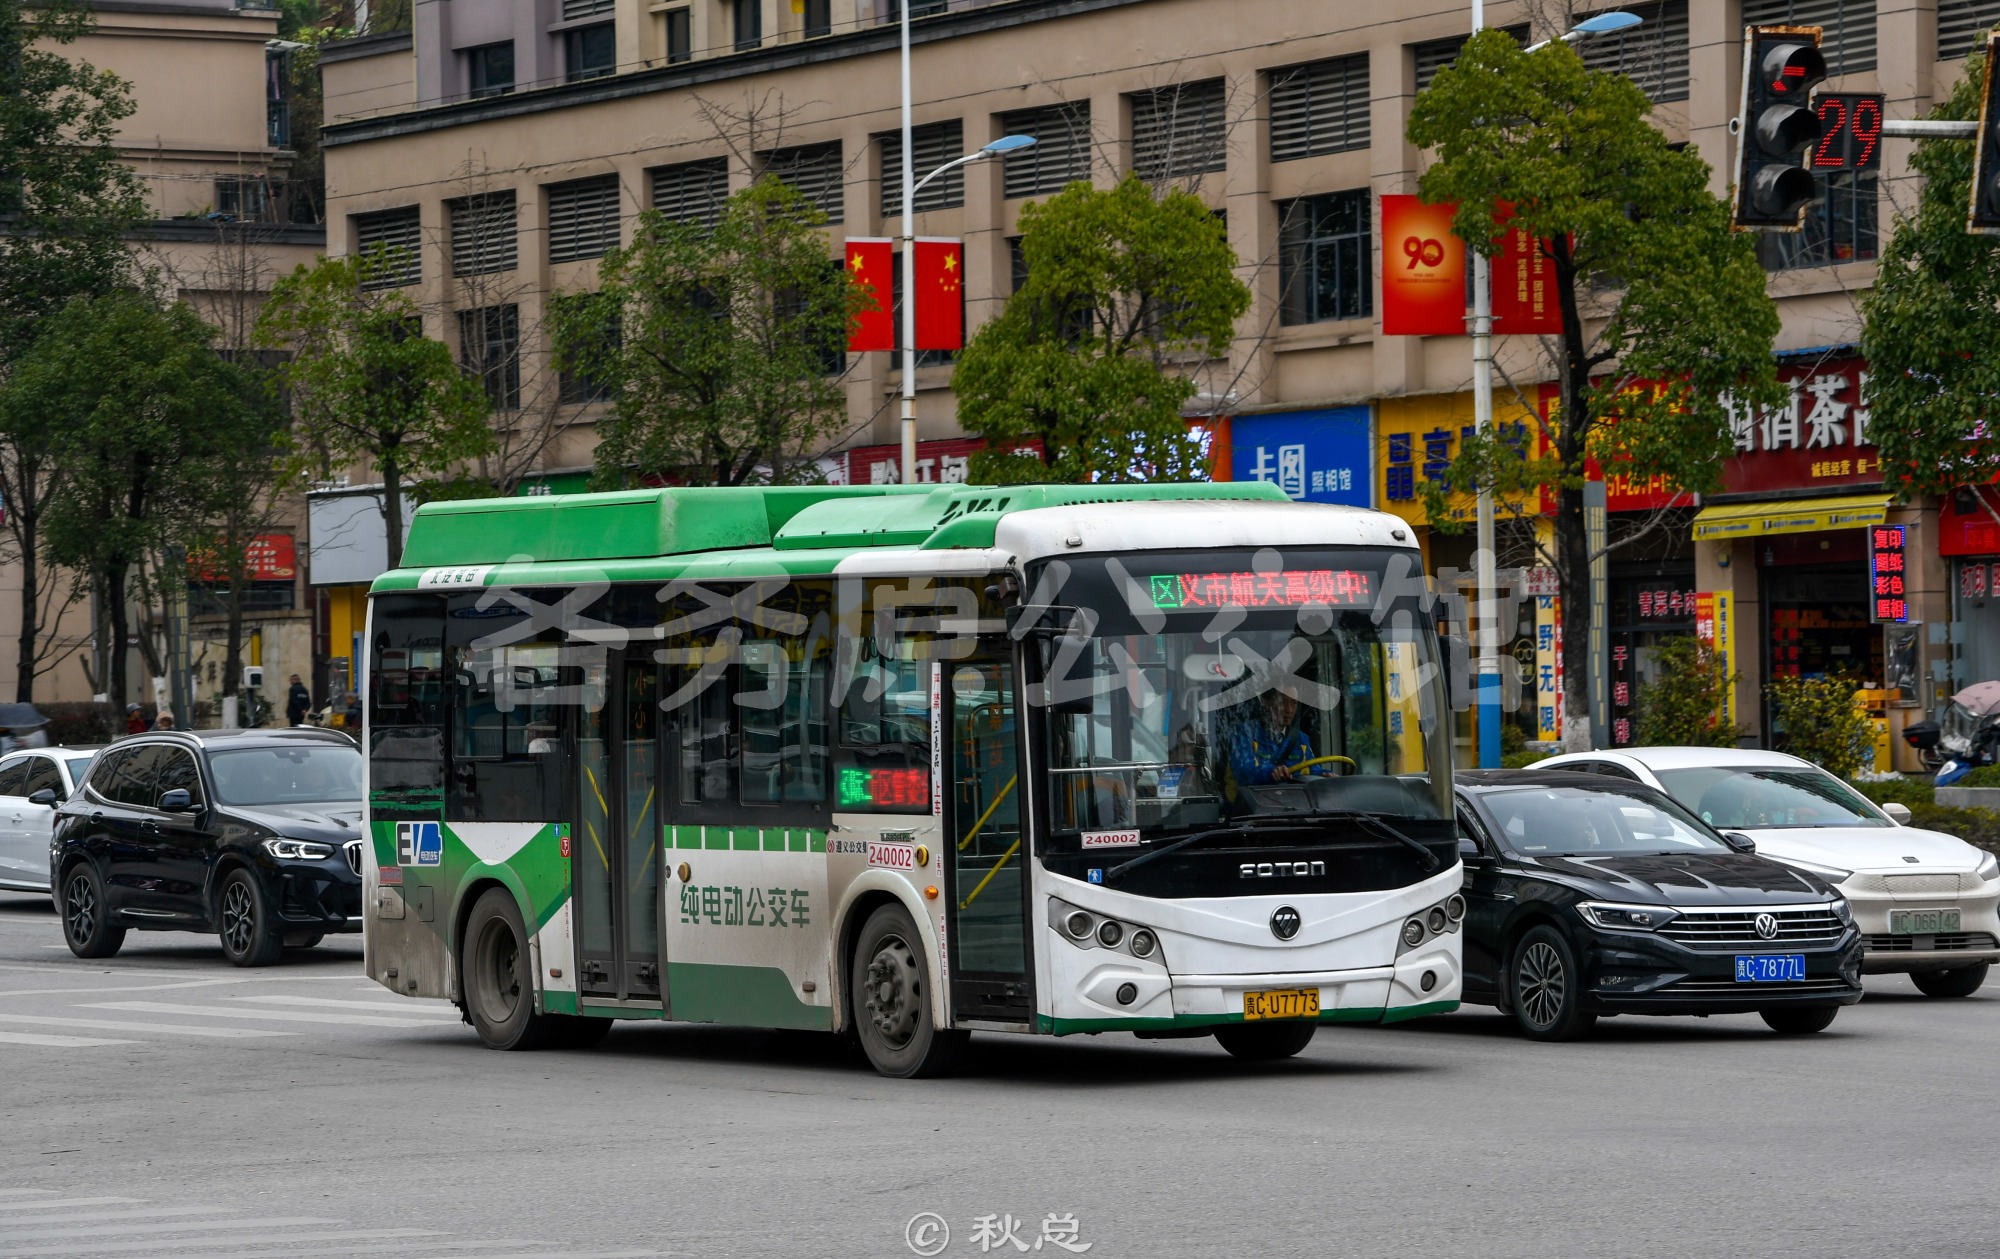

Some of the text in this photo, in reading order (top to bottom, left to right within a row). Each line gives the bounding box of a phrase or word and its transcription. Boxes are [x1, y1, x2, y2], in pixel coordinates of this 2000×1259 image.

[1813, 98, 1882, 168] 29
[1403, 236, 1445, 270] 90
[1811, 460, 1851, 478] 诚信经营
[1311, 469, 1352, 493] 照相馆
[1873, 529, 1902, 549] 复印
[1875, 553, 1903, 572] 图纸
[1875, 576, 1904, 595] 彩色
[1877, 599, 1904, 618] 照相
[1085, 834, 1137, 846] 240002
[869, 846, 912, 867] 240002
[1239, 861, 1326, 878] FOTON
[680, 885, 810, 929] 纯电动公交车
